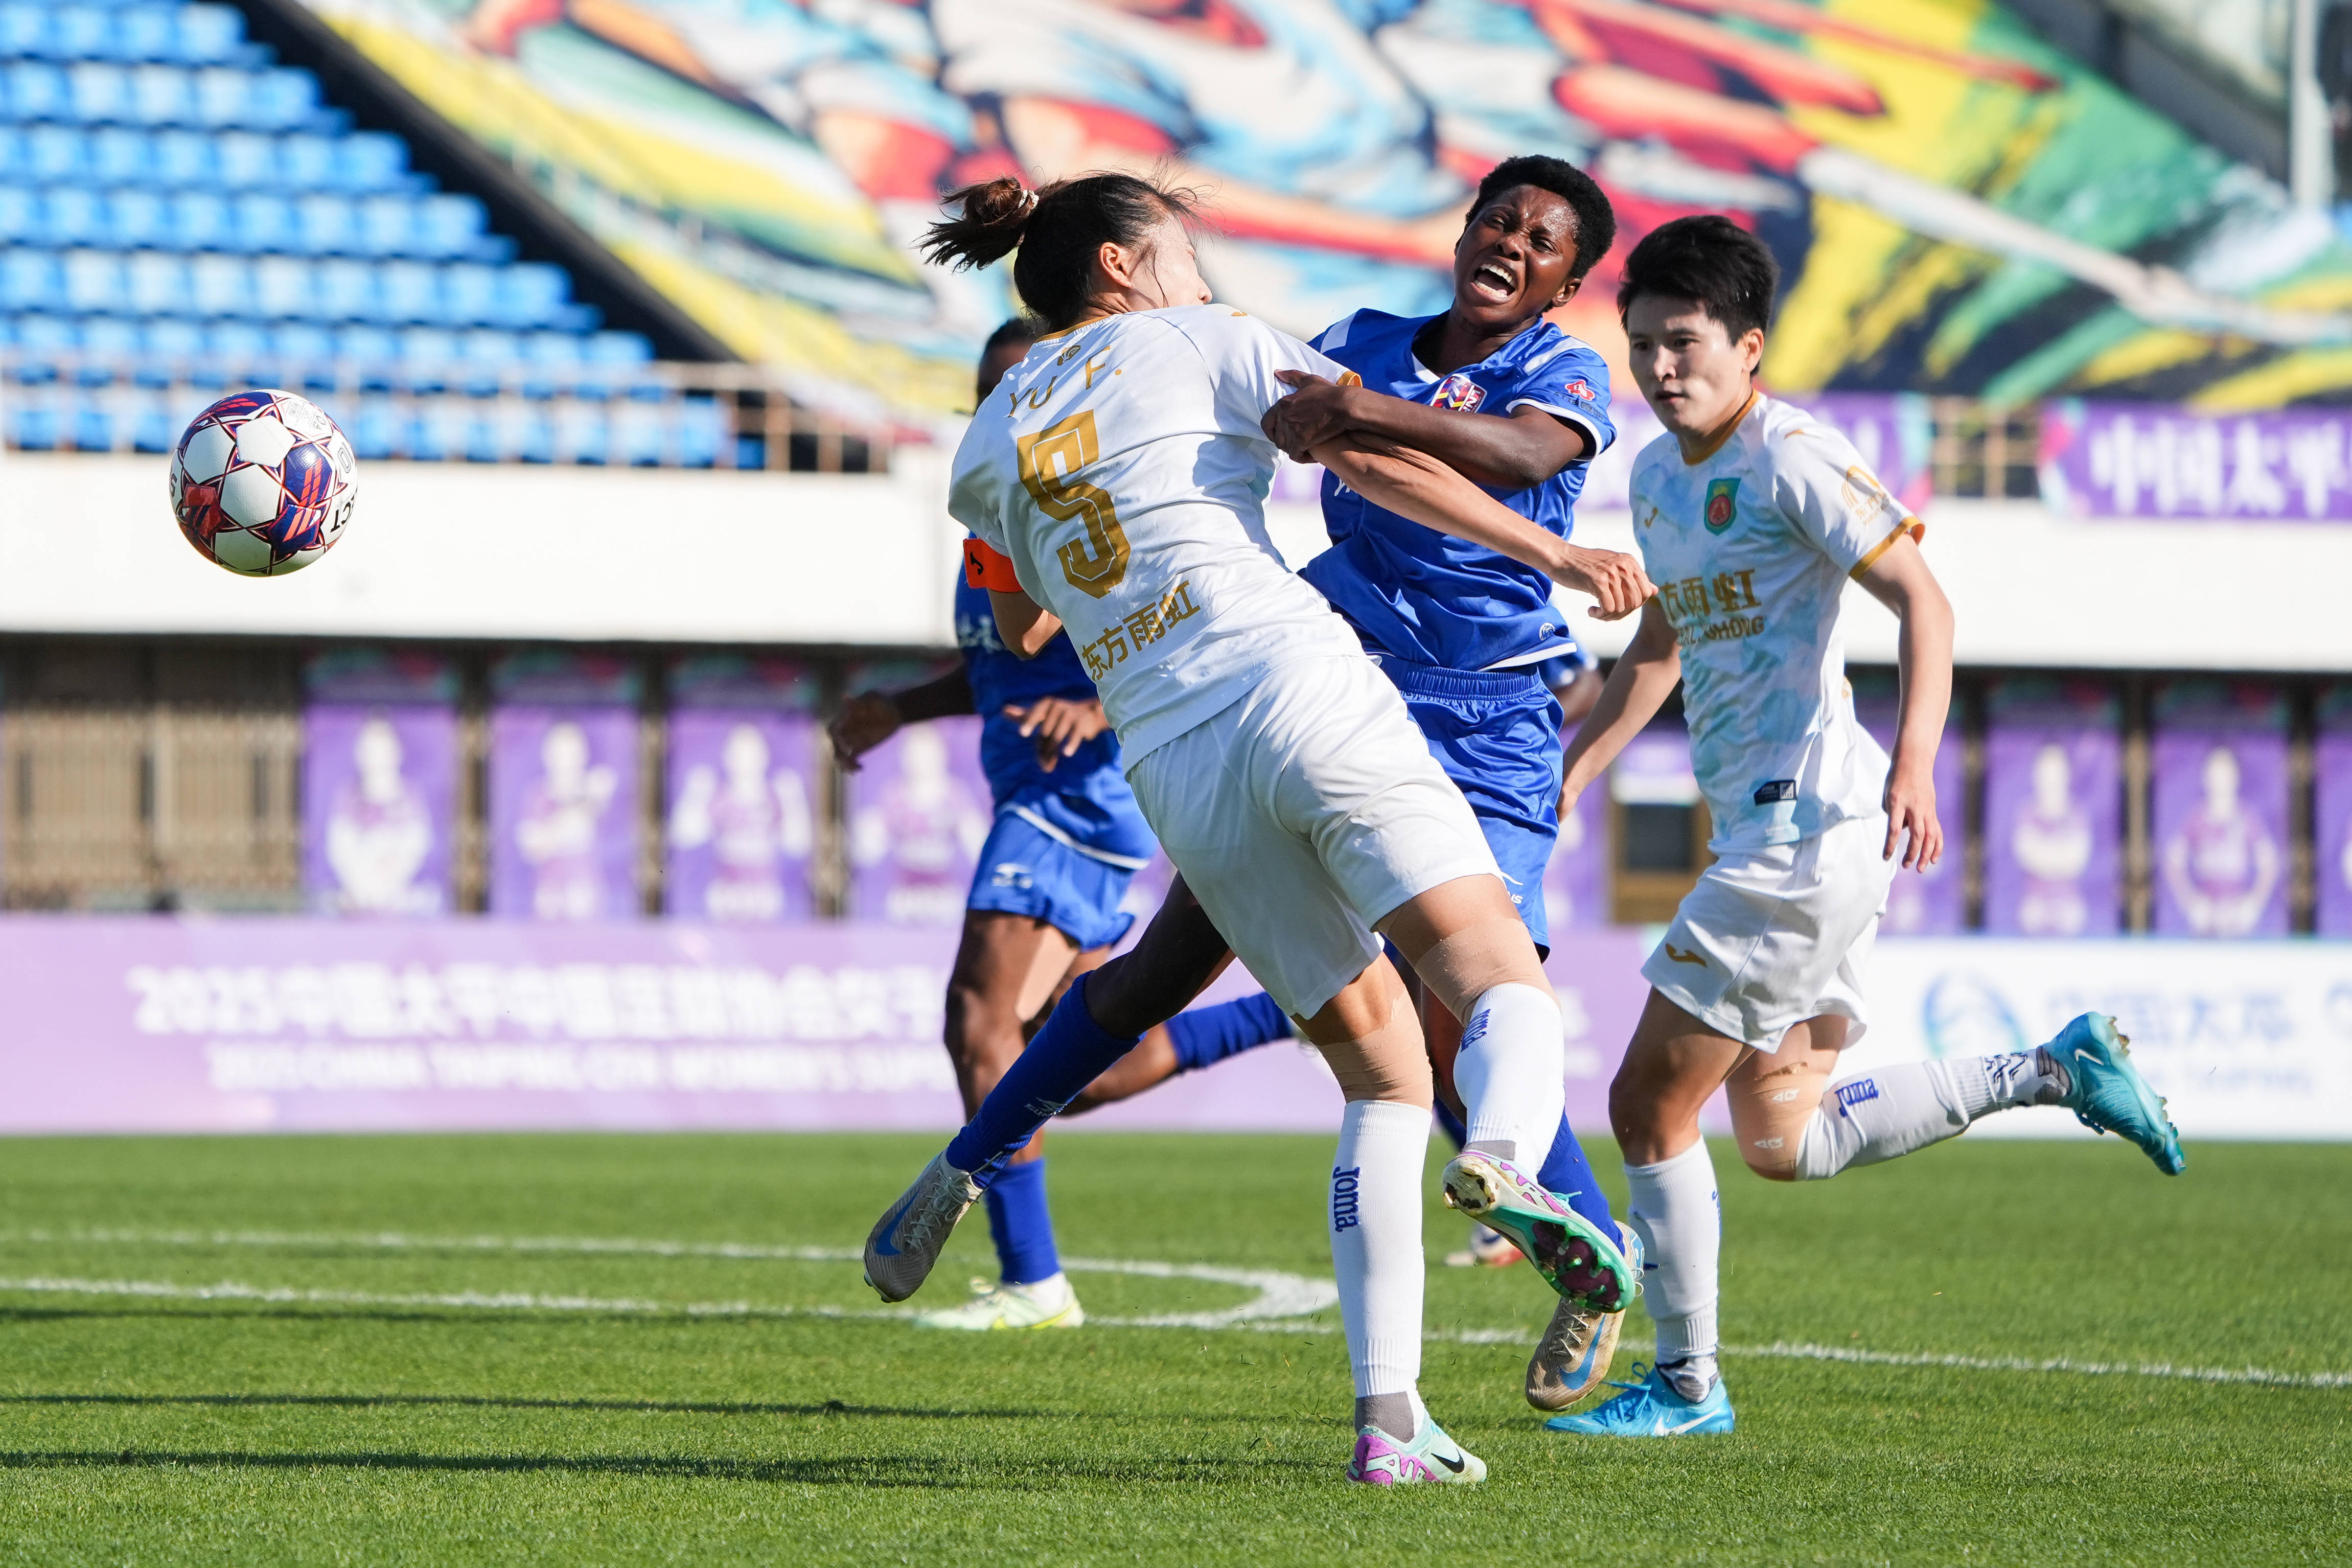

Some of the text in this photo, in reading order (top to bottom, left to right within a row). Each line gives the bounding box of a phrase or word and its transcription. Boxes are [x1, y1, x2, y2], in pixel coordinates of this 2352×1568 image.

[1008, 344, 1122, 418] YU F.
[1017, 409, 1132, 599] 5
[1081, 580, 1201, 682] 东方雨虹
